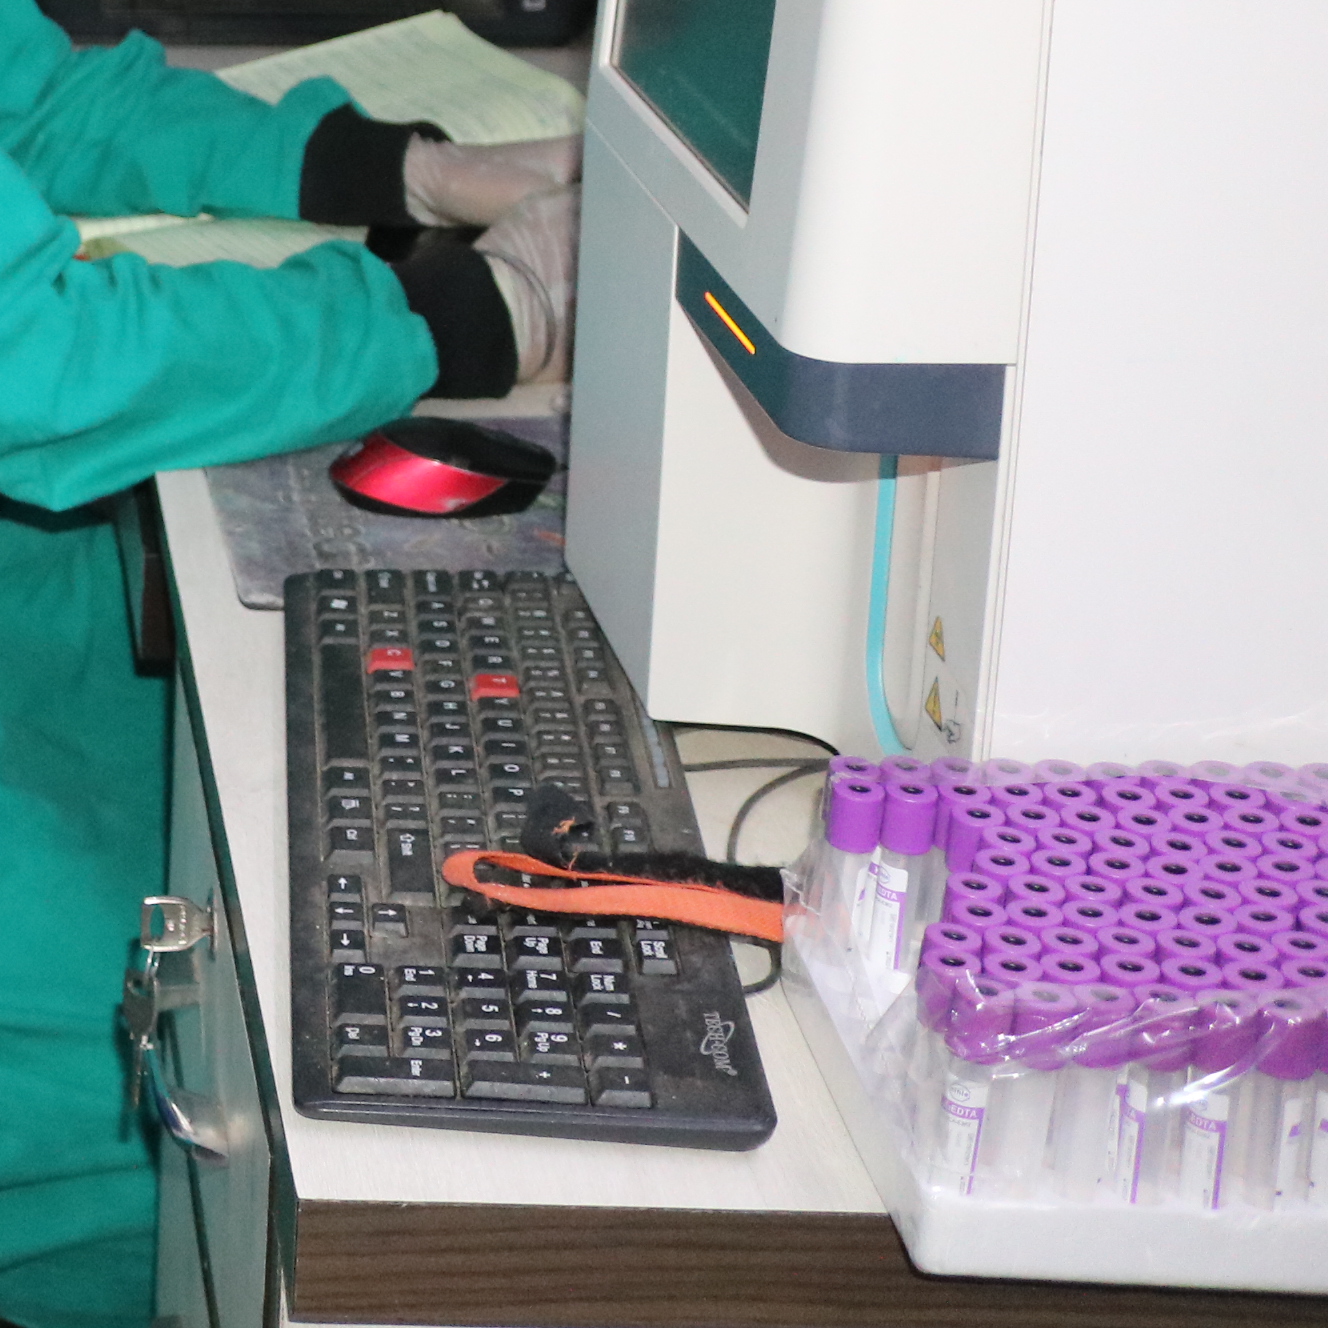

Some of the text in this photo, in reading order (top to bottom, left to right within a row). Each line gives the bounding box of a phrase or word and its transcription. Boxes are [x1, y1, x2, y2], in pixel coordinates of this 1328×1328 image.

[484, 636, 500, 644] E
[488, 656, 503, 664] R
[440, 680, 455, 688] G
[497, 719, 513, 727] U
[395, 734, 410, 742] M
[504, 764, 520, 772] O
[509, 788, 524, 797] P
[464, 935, 475, 952] Down
[475, 935, 487, 951] Page
[524, 937, 536, 947] Up
[536, 938, 549, 954] Page
[590, 941, 603, 954] End
[641, 941, 654, 956] Lock
[654, 941, 668, 958] Scroll
[344, 965, 354, 976] Ins
[359, 966, 376, 974] 0
[404, 968, 416, 981] End
[526, 971, 537, 988] Home
[591, 975, 603, 990] Lock
[603, 975, 615, 990] Num
[421, 1002, 438, 1010] 2
[482, 1005, 499, 1013] 5
[345, 1027, 360, 1040] Del
[424, 1029, 442, 1037] 3
[485, 1034, 502, 1042] 6
[410, 1060, 422, 1076] Enter
